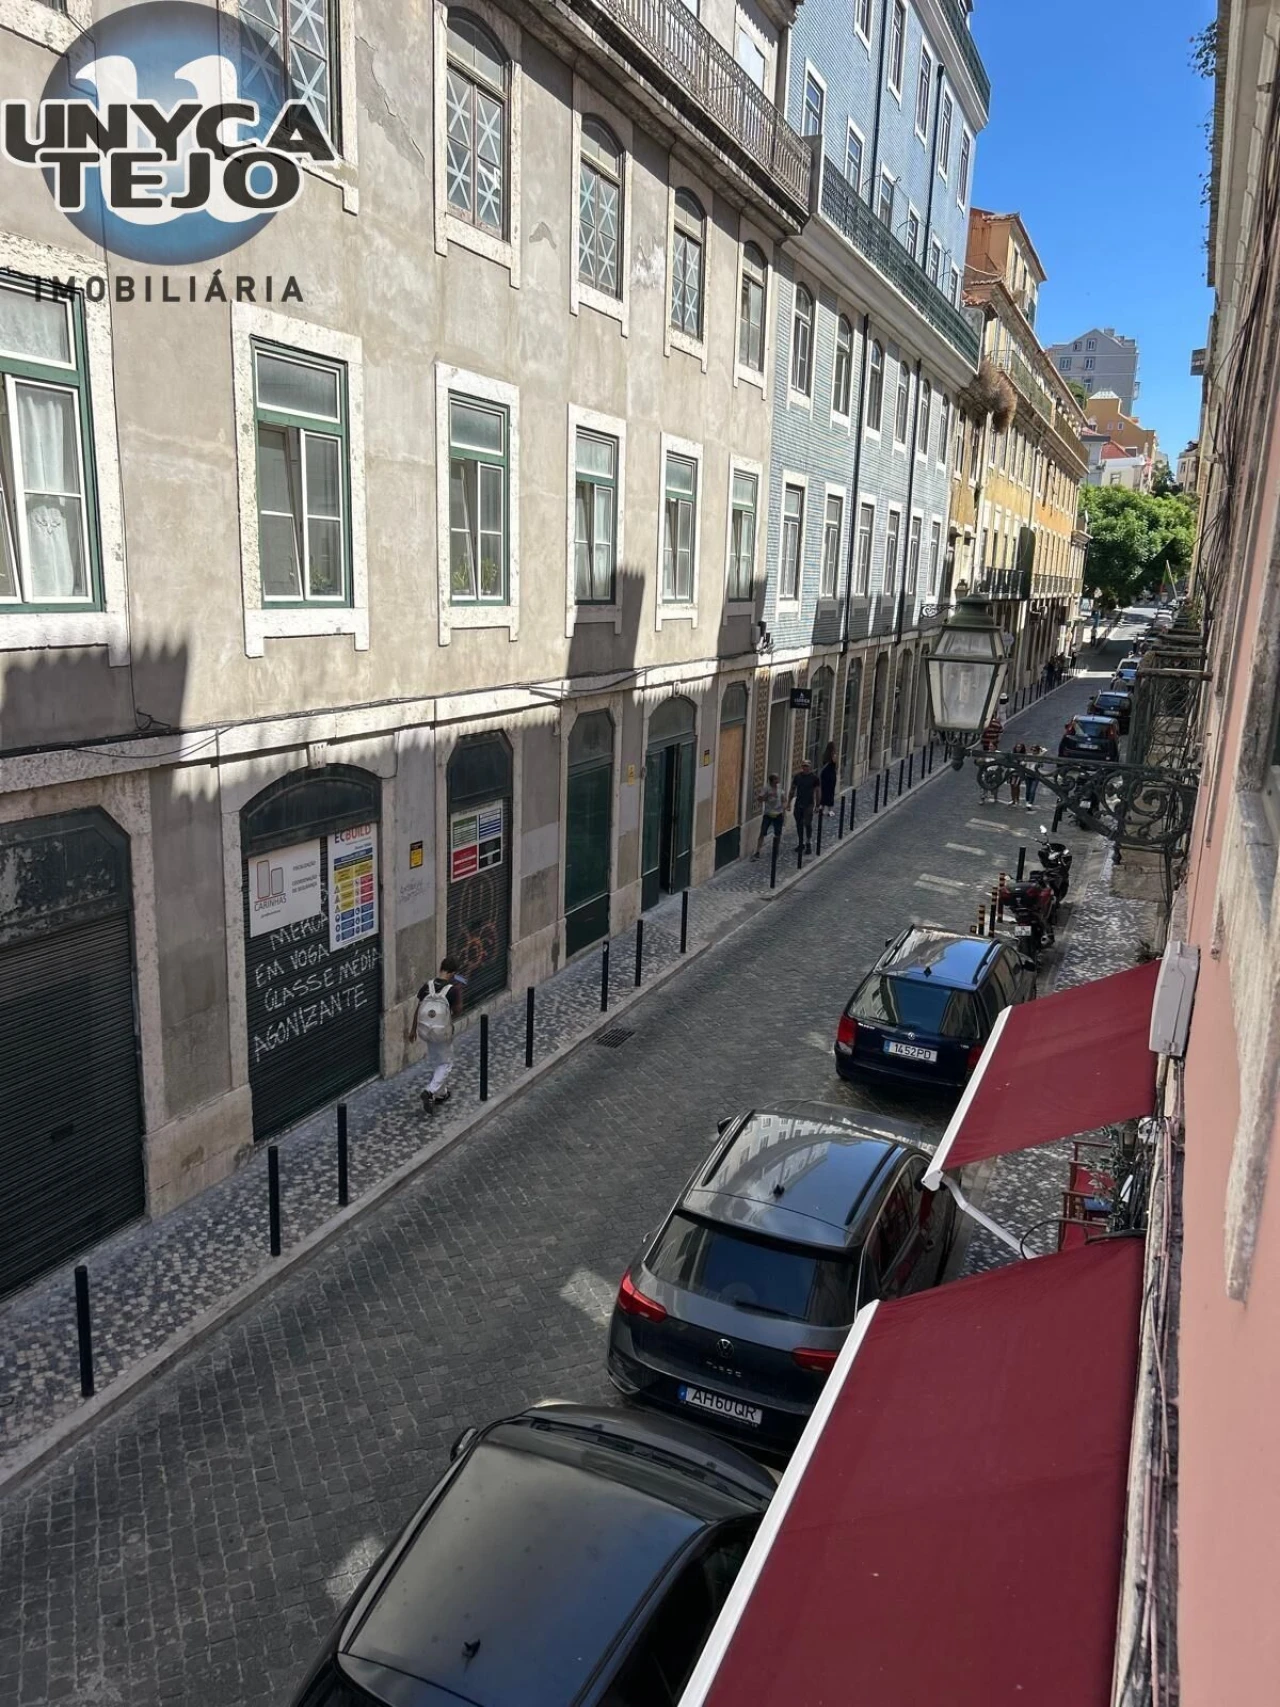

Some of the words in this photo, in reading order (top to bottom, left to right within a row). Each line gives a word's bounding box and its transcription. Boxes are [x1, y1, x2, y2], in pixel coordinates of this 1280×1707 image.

[255, 959, 285, 988] EM
[289, 943, 330, 970] VOGA
[253, 983, 368, 1063] AGONIZANTE
